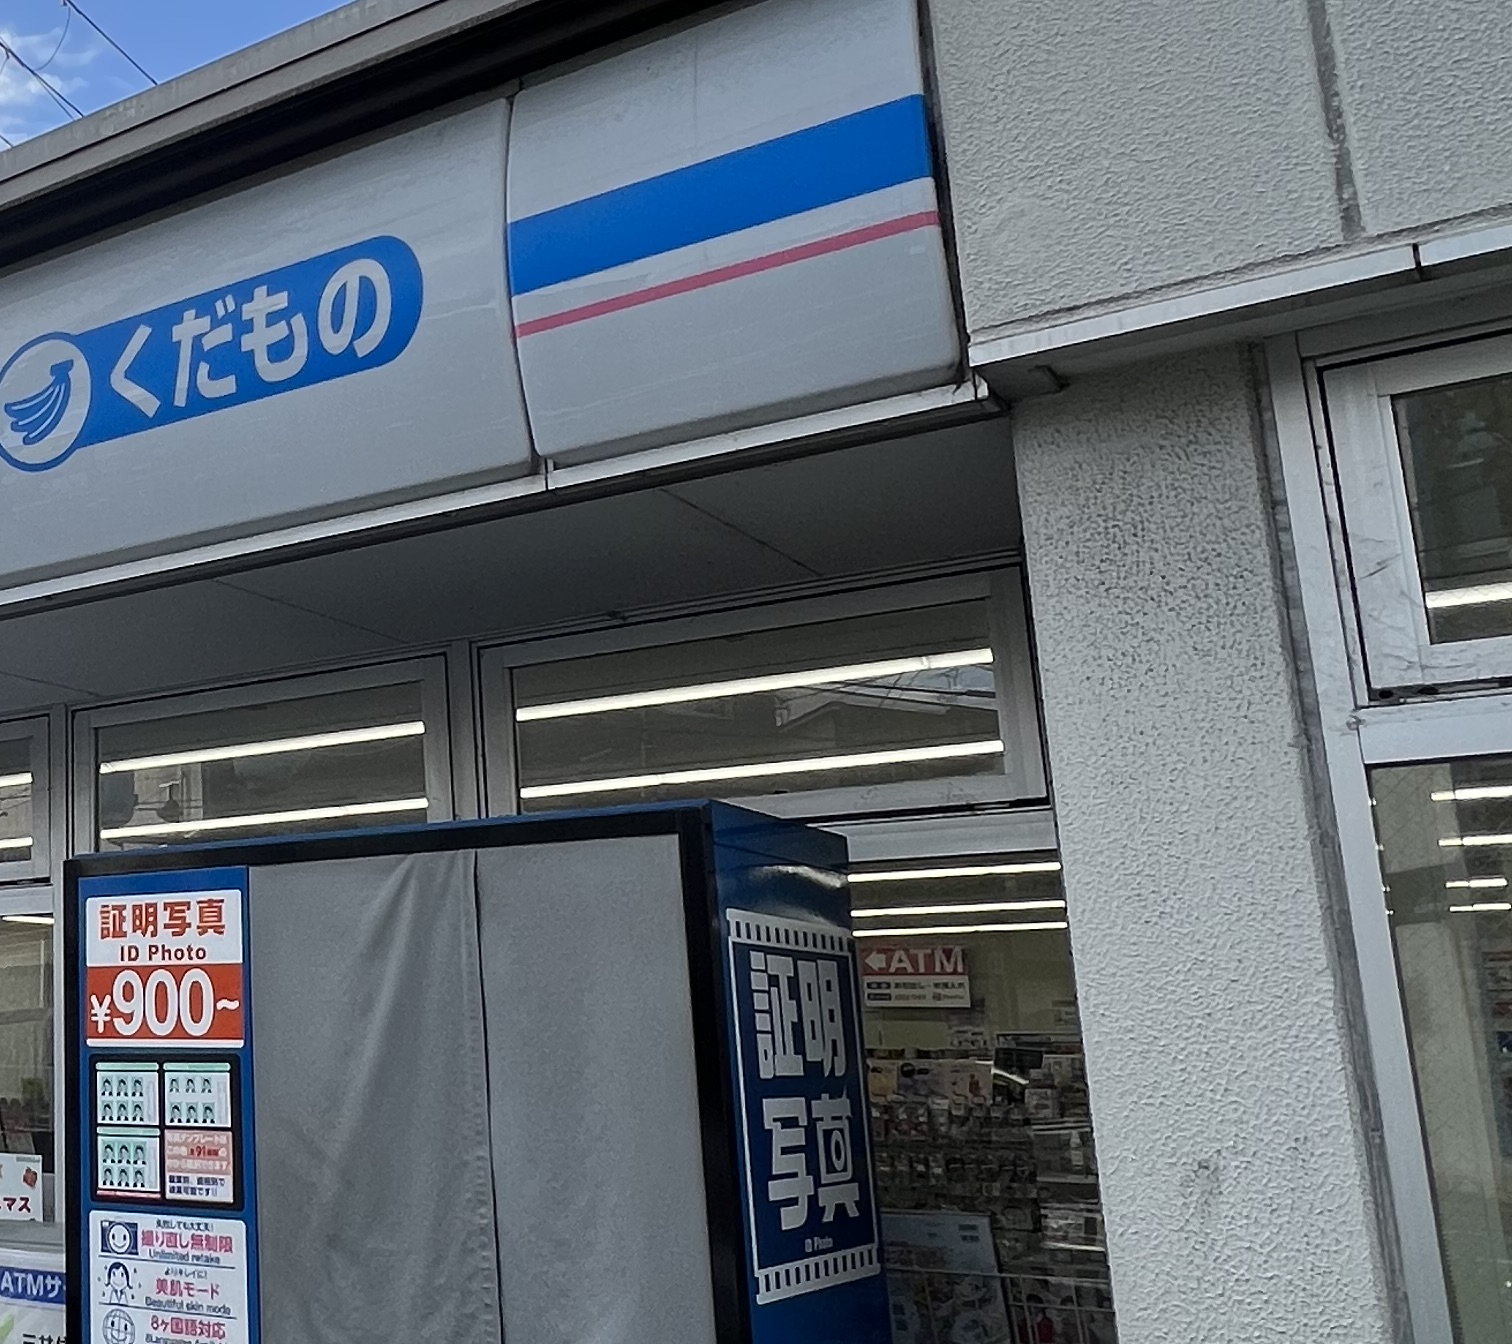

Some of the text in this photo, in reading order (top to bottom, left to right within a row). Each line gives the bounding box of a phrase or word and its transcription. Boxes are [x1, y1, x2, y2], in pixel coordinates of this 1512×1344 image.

[109, 257, 394, 419] くだもの
[99, 898, 227, 940] 証明写真
[120, 942, 207, 963] ID Photo
[888, 946, 964, 974] ATM
[749, 949, 847, 1080] 証明
[761, 1084, 861, 1231] 写真
[0, 1270, 67, 1299] ATMサ
[155, 1277, 221, 1301] 美肌モード
